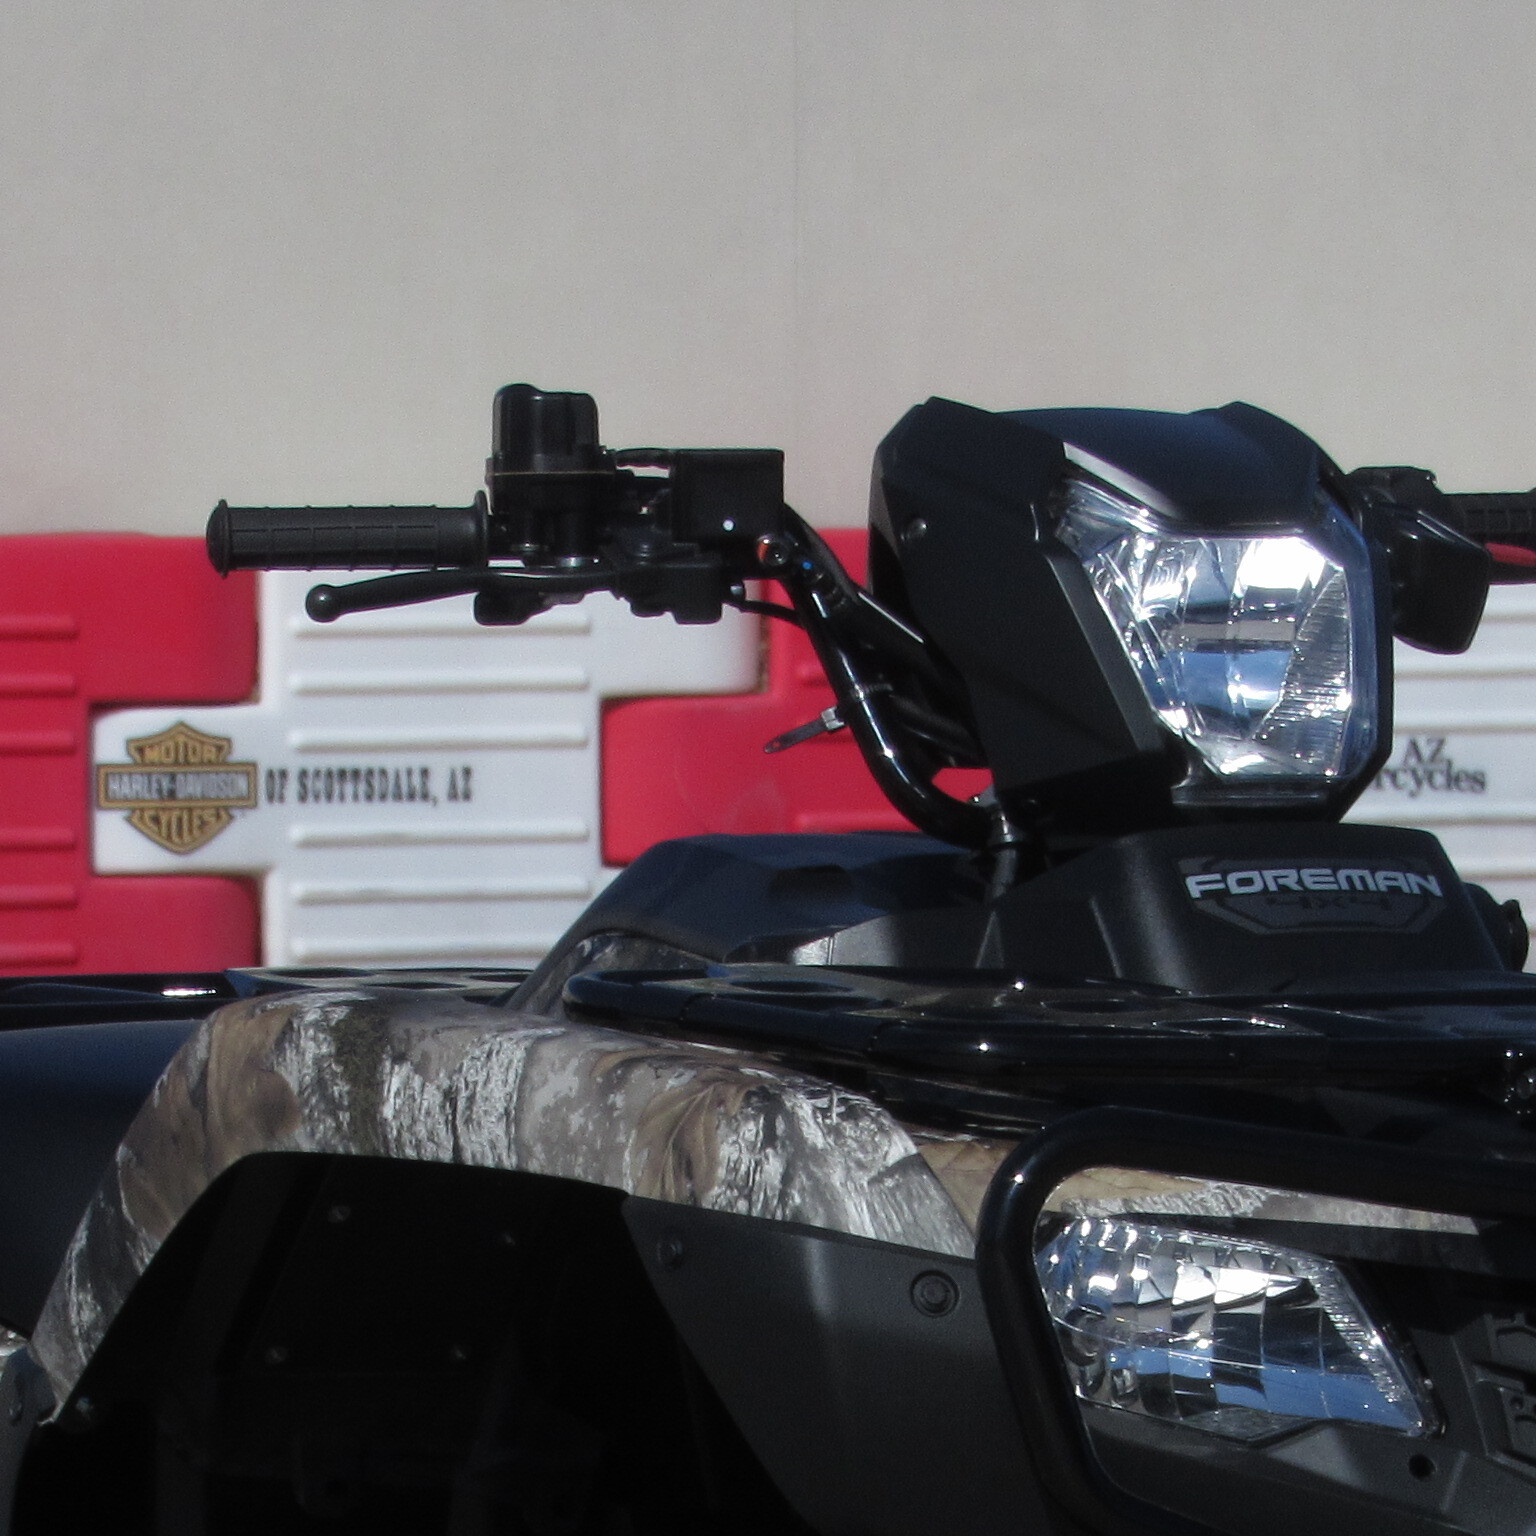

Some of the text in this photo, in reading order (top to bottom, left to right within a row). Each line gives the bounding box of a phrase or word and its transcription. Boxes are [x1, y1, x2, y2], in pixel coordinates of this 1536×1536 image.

[145, 742, 218, 765] MOTOR
[1402, 737, 1447, 767] AZ
[107, 772, 249, 802] HARLEY-DAVIDSON
[265, 765, 474, 806] OF SCOTTSDALE, AZ
[147, 808, 218, 845] CYCLES
[1184, 868, 1444, 900] FOREMAN
